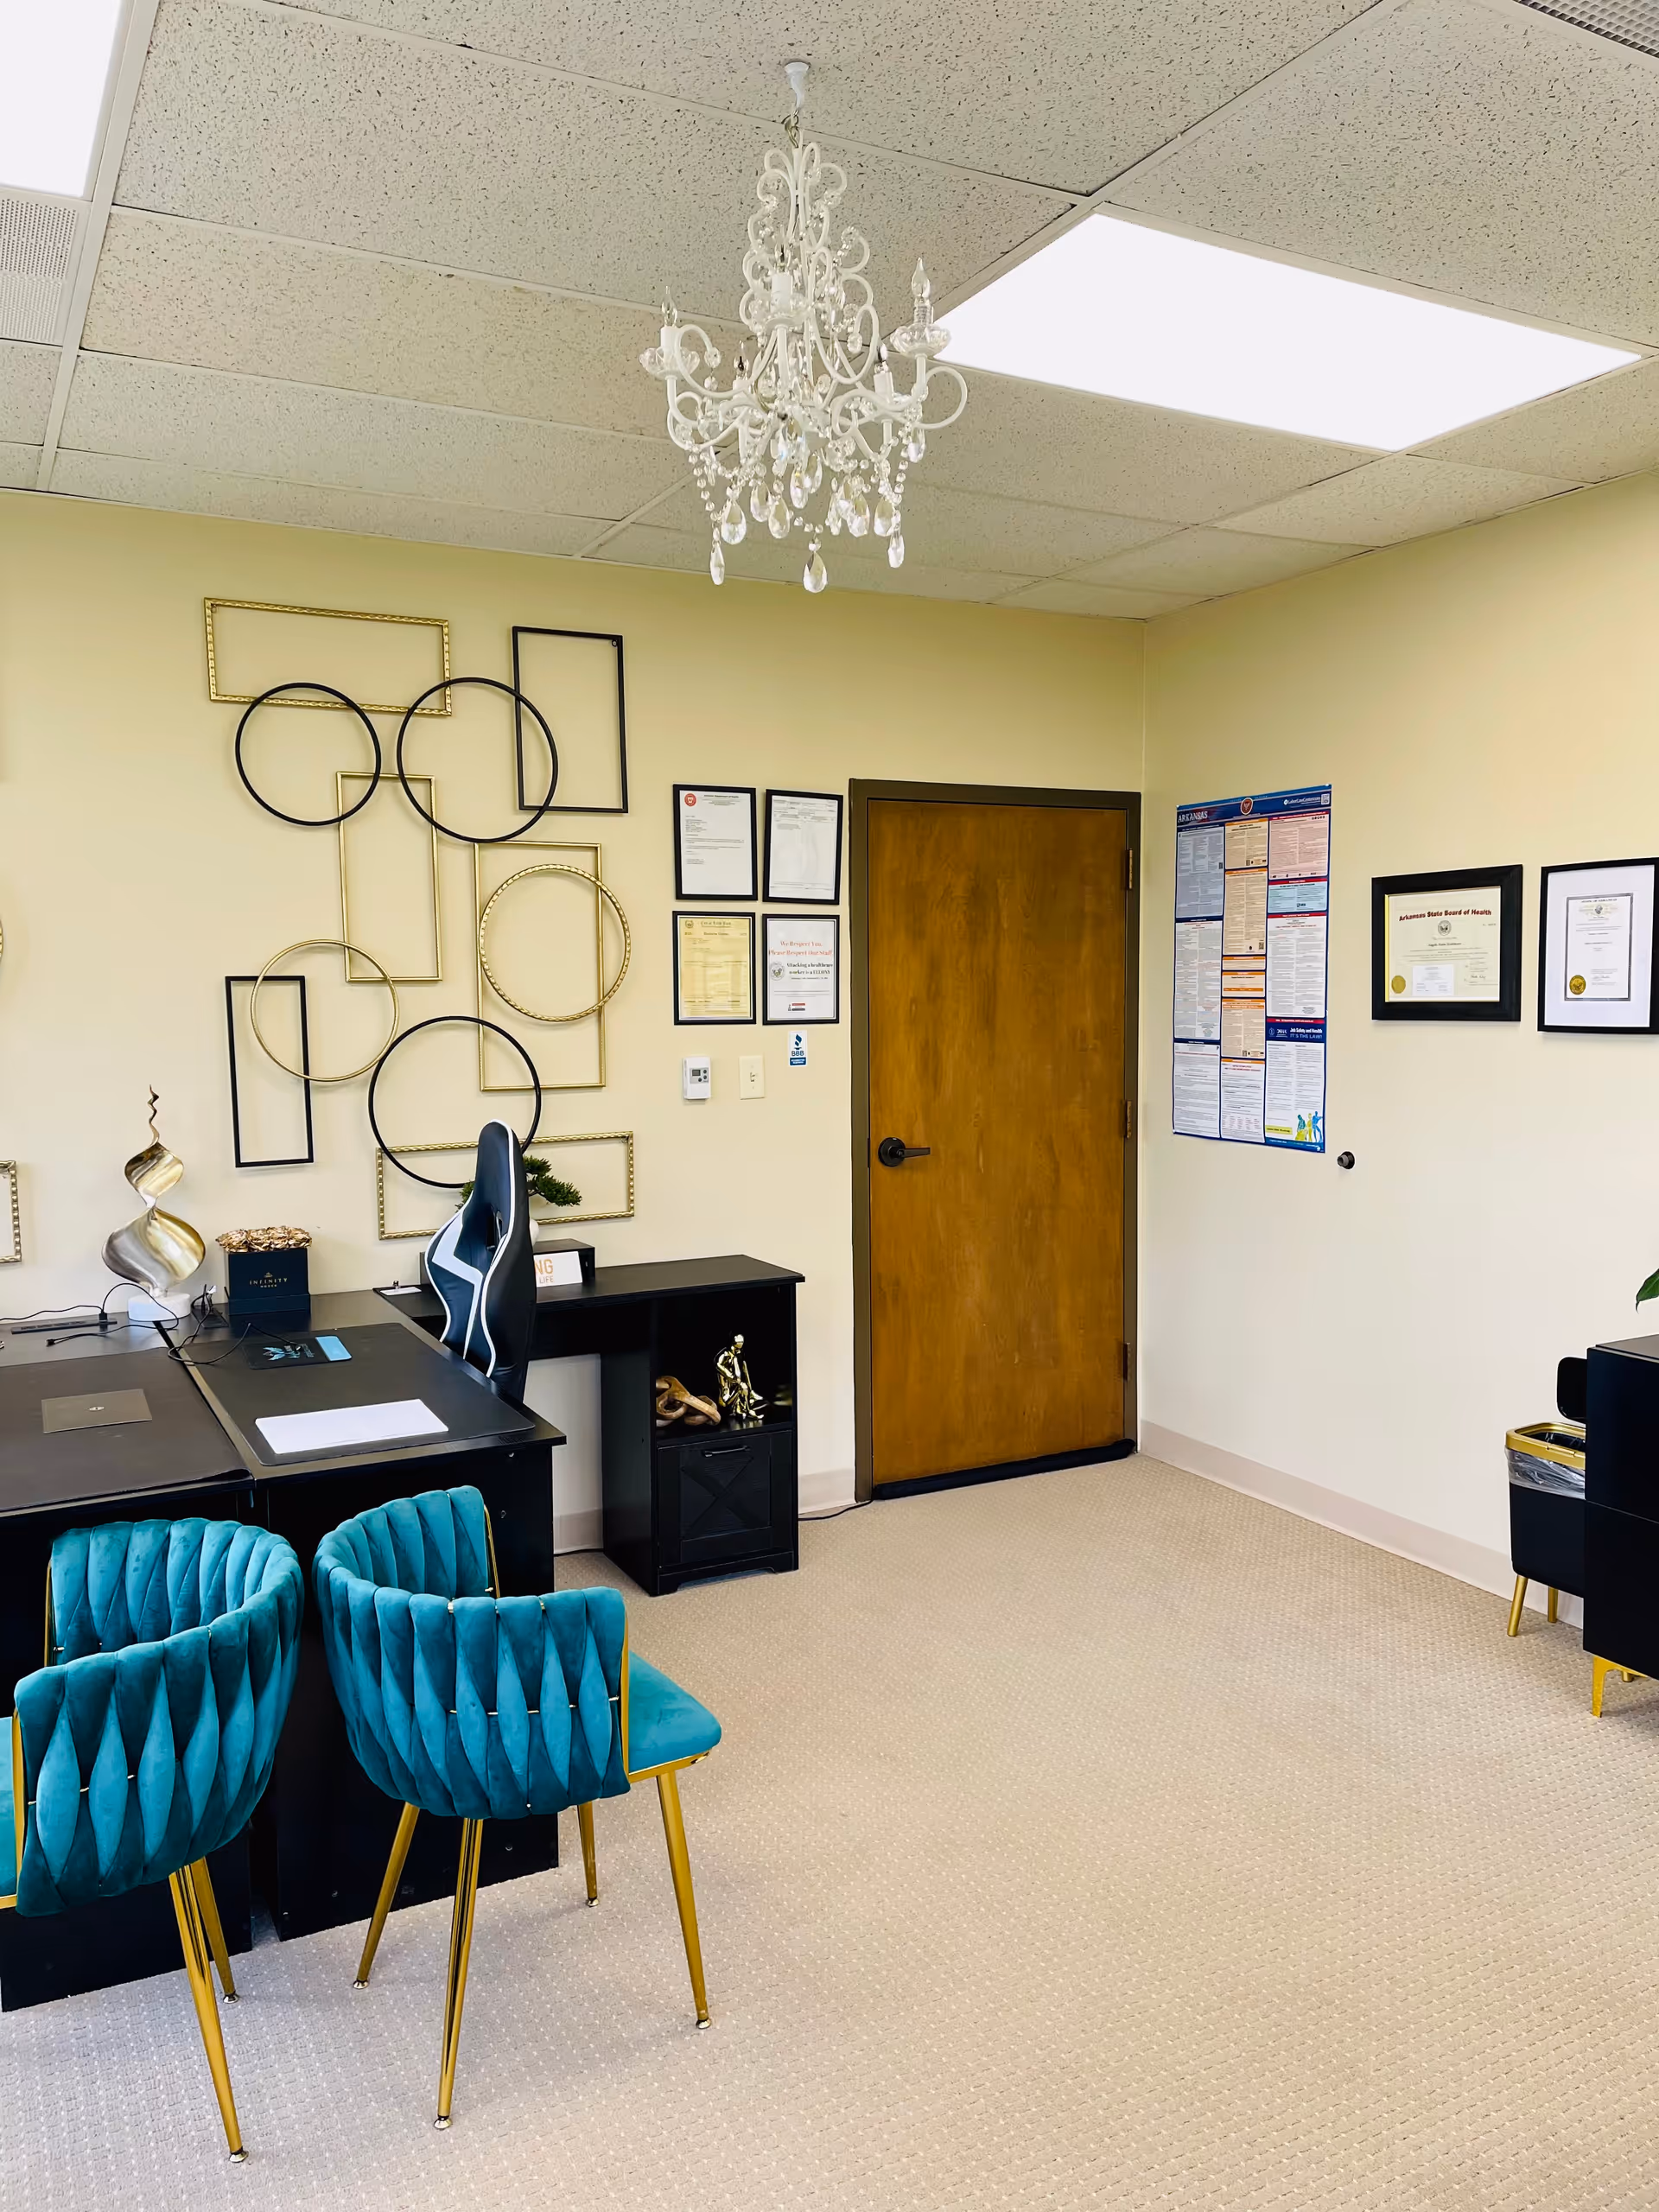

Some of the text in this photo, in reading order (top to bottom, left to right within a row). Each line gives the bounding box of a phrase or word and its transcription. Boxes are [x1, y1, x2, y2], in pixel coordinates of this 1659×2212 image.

[1178, 810, 1208, 823] ARKANSAS
[1399, 912, 1426, 922] Arkansas
[249, 1277, 288, 1286] INFINITY
[539, 1275, 554, 1284] LIFE
